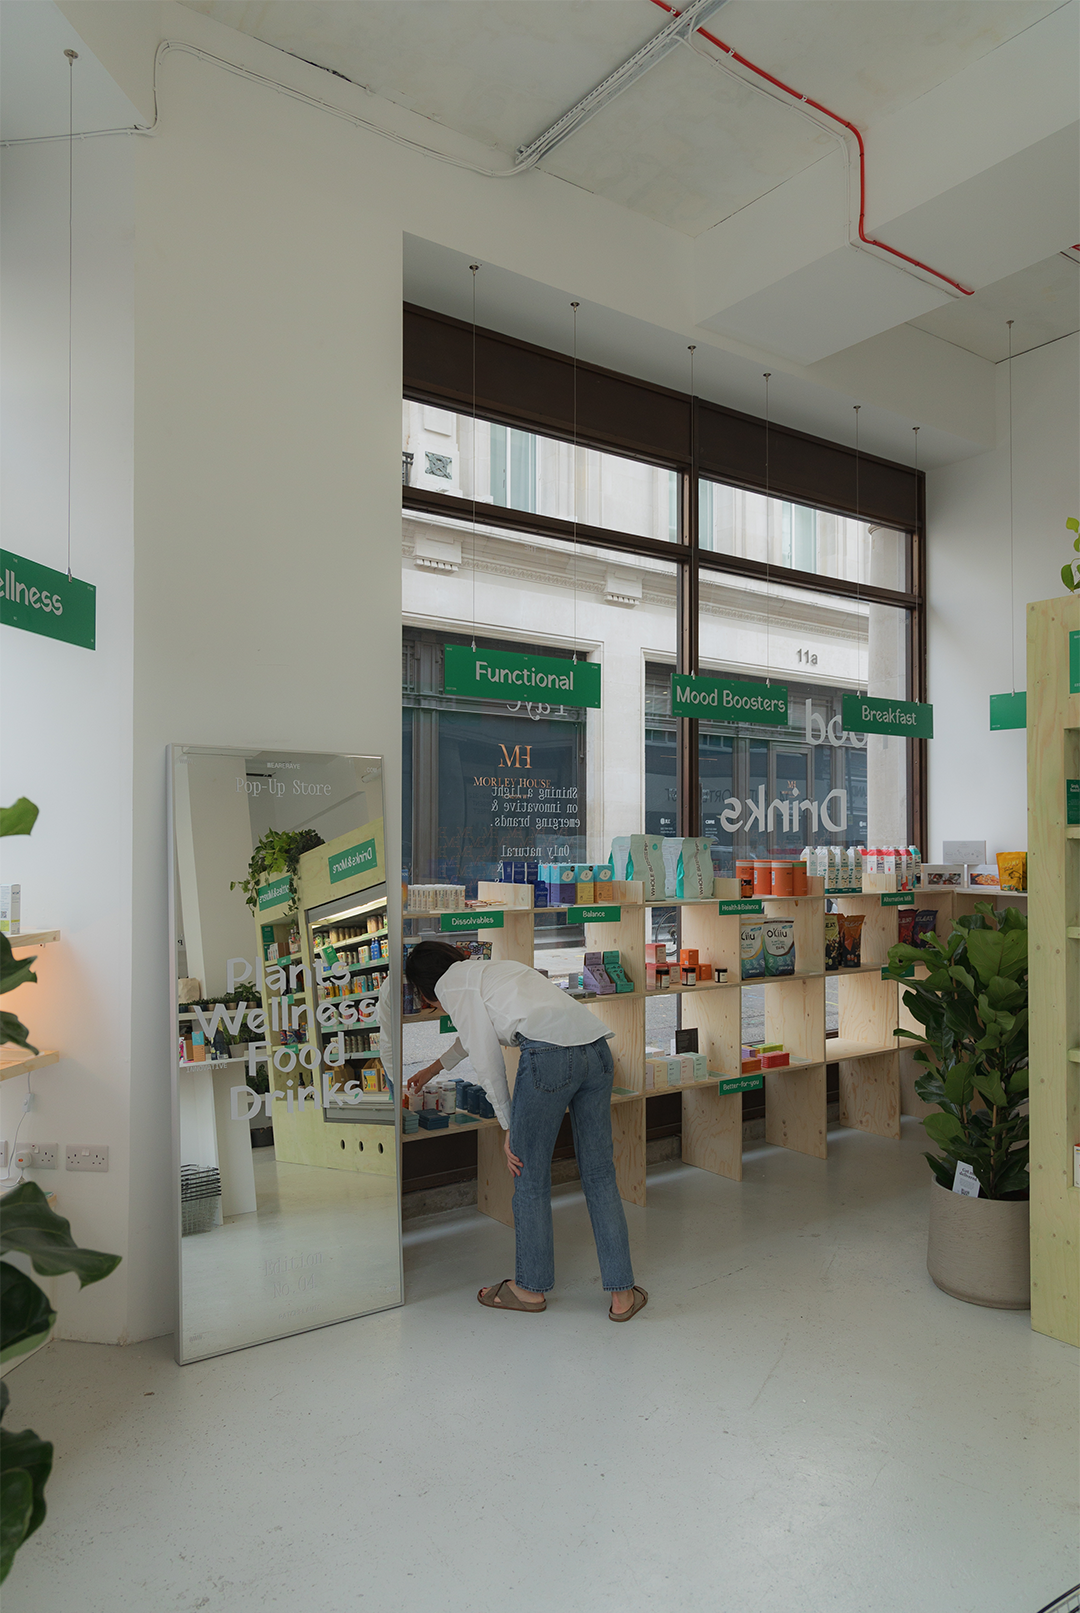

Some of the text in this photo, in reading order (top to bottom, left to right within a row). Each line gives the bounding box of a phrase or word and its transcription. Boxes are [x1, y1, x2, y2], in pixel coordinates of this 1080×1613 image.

[797, 648, 818, 665] 11a
[475, 660, 574, 691] Functional
[676, 685, 786, 713] Mood Boosters
[861, 704, 917, 726] Breakfast
[235, 777, 332, 798] Pop-Up Store
[473, 776, 552, 789] MORLEY HOUSE
[582, 909, 606, 918] Balance
[721, 902, 760, 912] Health&Balance
[451, 915, 494, 927] Dissolvables
[226, 956, 351, 995] Plants
[193, 995, 379, 1039] Wellness
[248, 1031, 346, 1077] Food
[186, 1063, 228, 1073] INNOVATIVE
[722, 1079, 761, 1091] Better-for-you
[230, 1073, 364, 1121] Drinks
[263, 1251, 323, 1277] Edition
